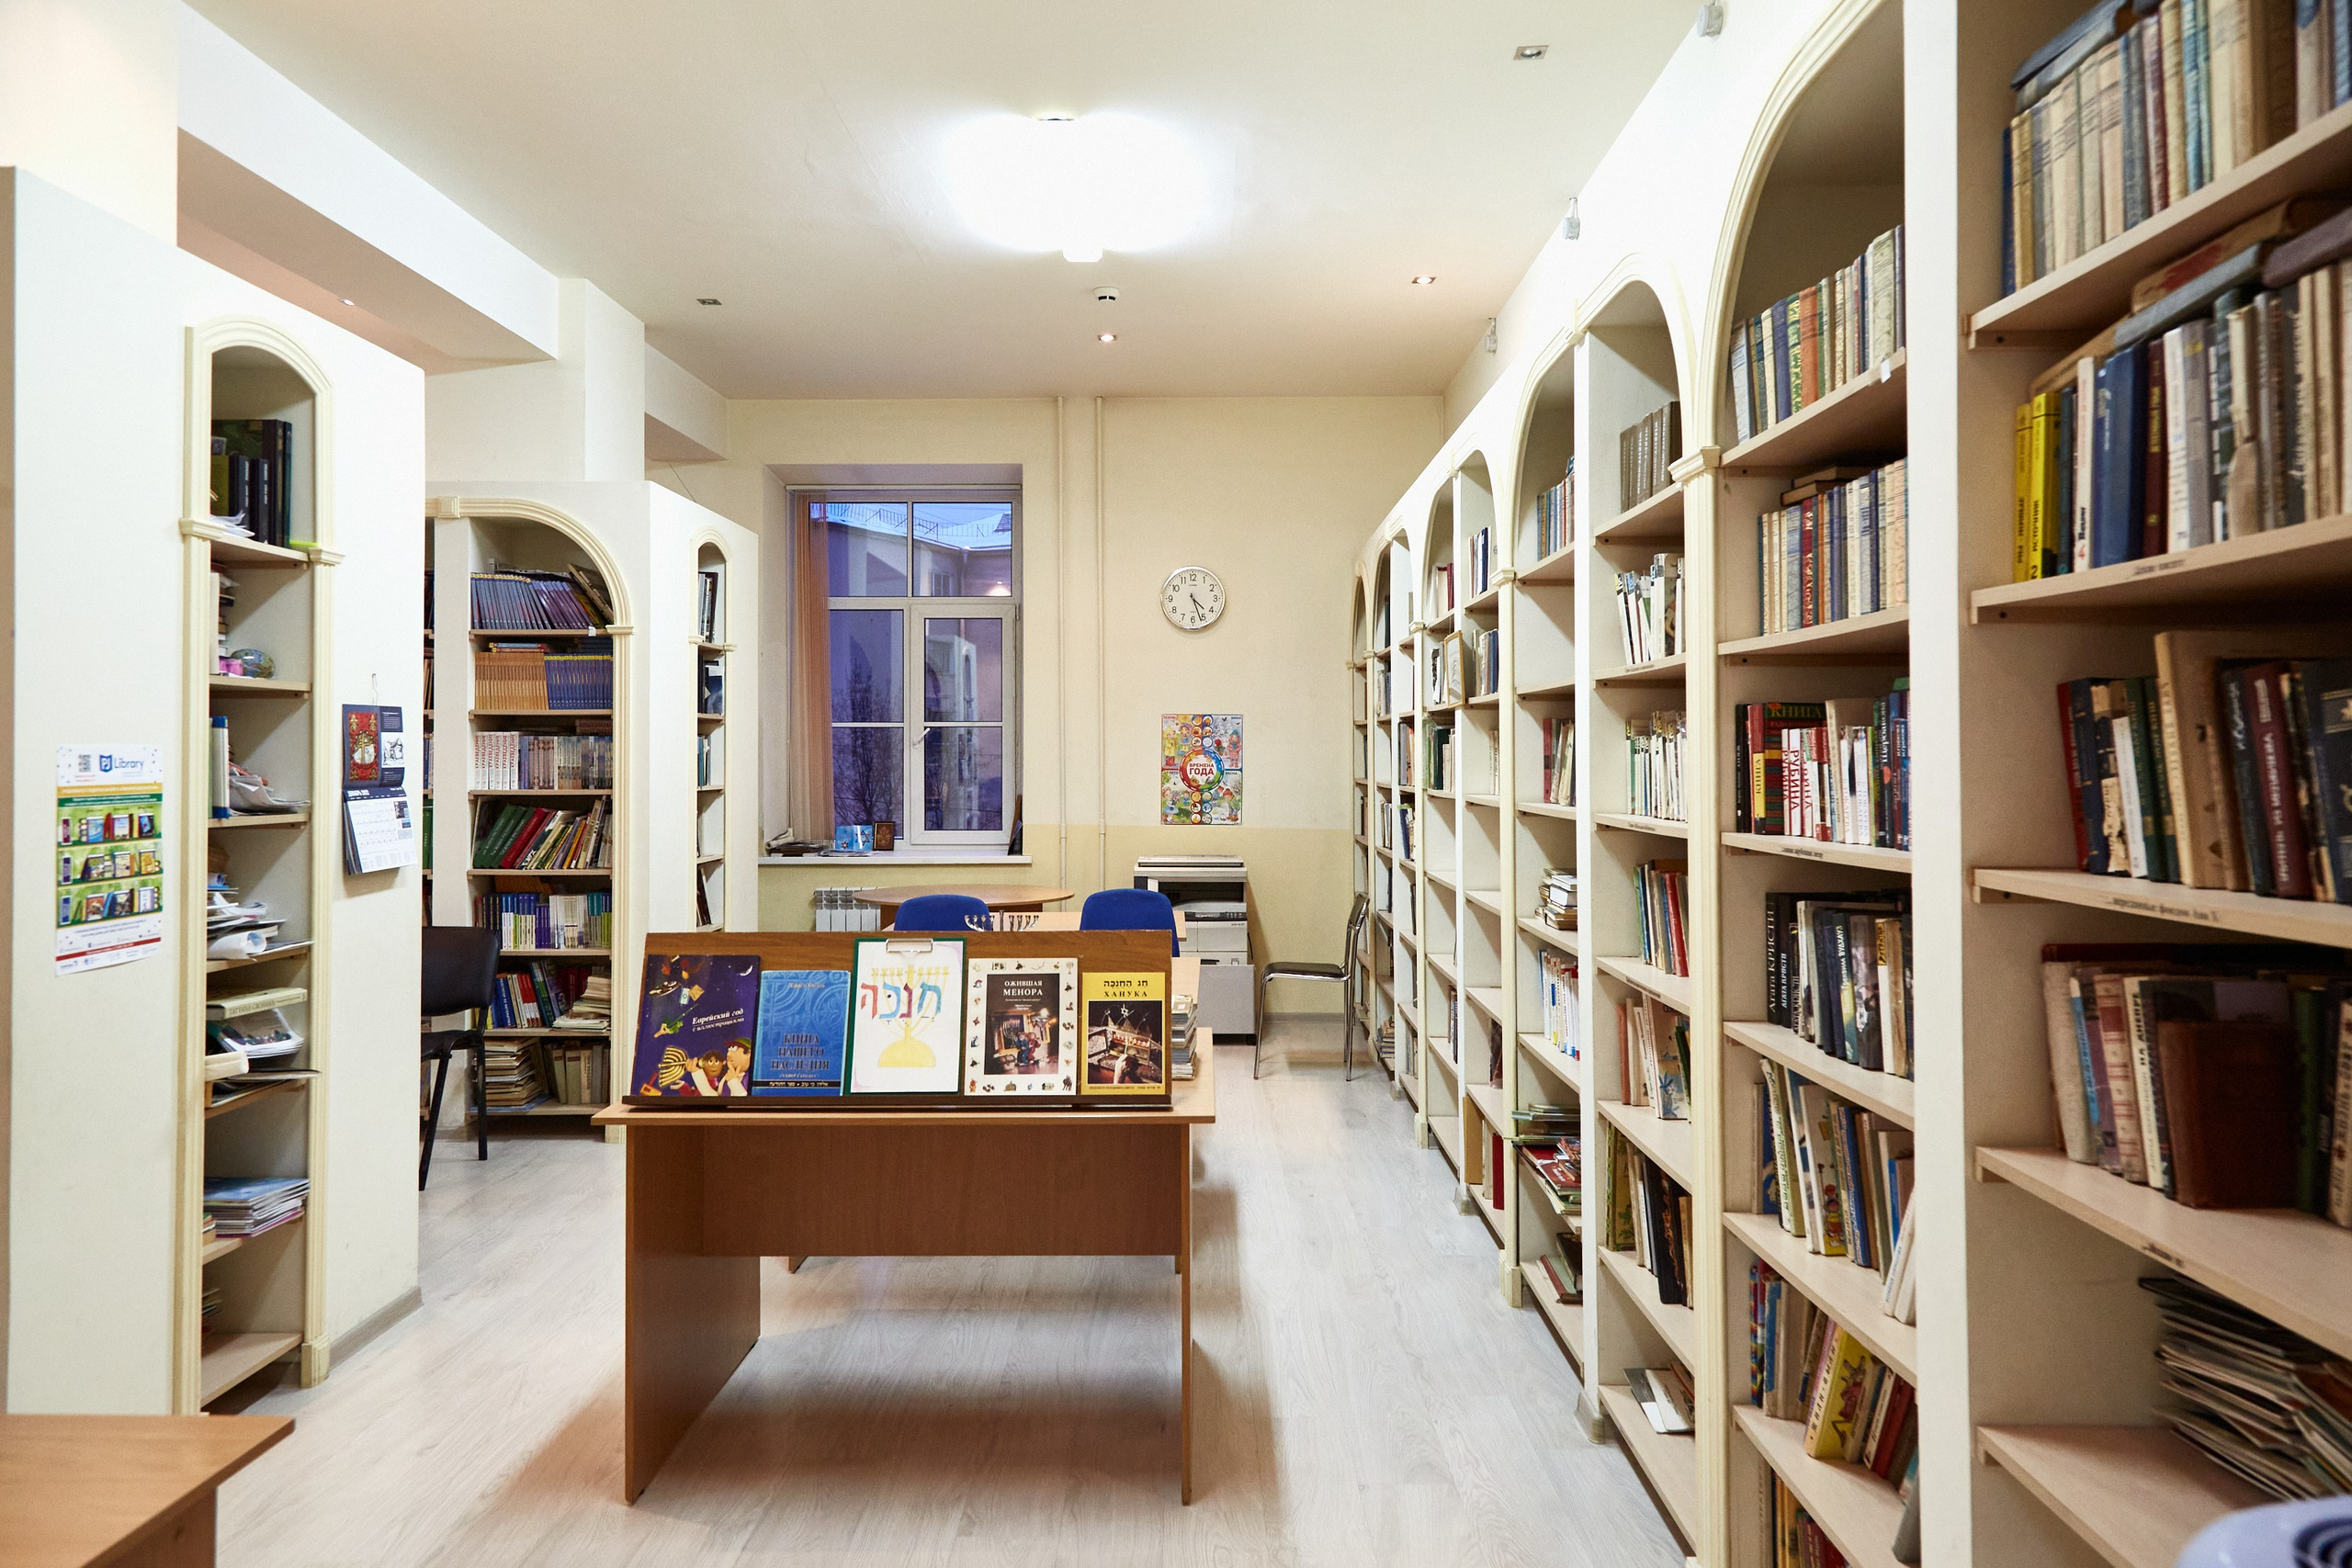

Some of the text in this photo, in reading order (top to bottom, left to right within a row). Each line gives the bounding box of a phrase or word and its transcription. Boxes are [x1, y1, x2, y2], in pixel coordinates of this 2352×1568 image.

[1172, 584, 1181, 592] 10
[114, 758, 144, 770] Library
[1189, 768, 1215, 776] ГОДА
[1791, 750, 1800, 810] РУБИНА
[1836, 925, 1845, 958] ВУДХАУЗ
[1767, 910, 1777, 1013] Агата КРИСТИ
[1003, 988, 1044, 997] МЕНОРА
[692, 1008, 744, 1025] Еврейский год
[696, 1017, 745, 1032] иллюстрациями
[784, 1033, 820, 1044] КНИГА
[778, 1046, 824, 1057] НАШЕГО
[771, 1059, 830, 1070] НАСЛЕДИЯ
